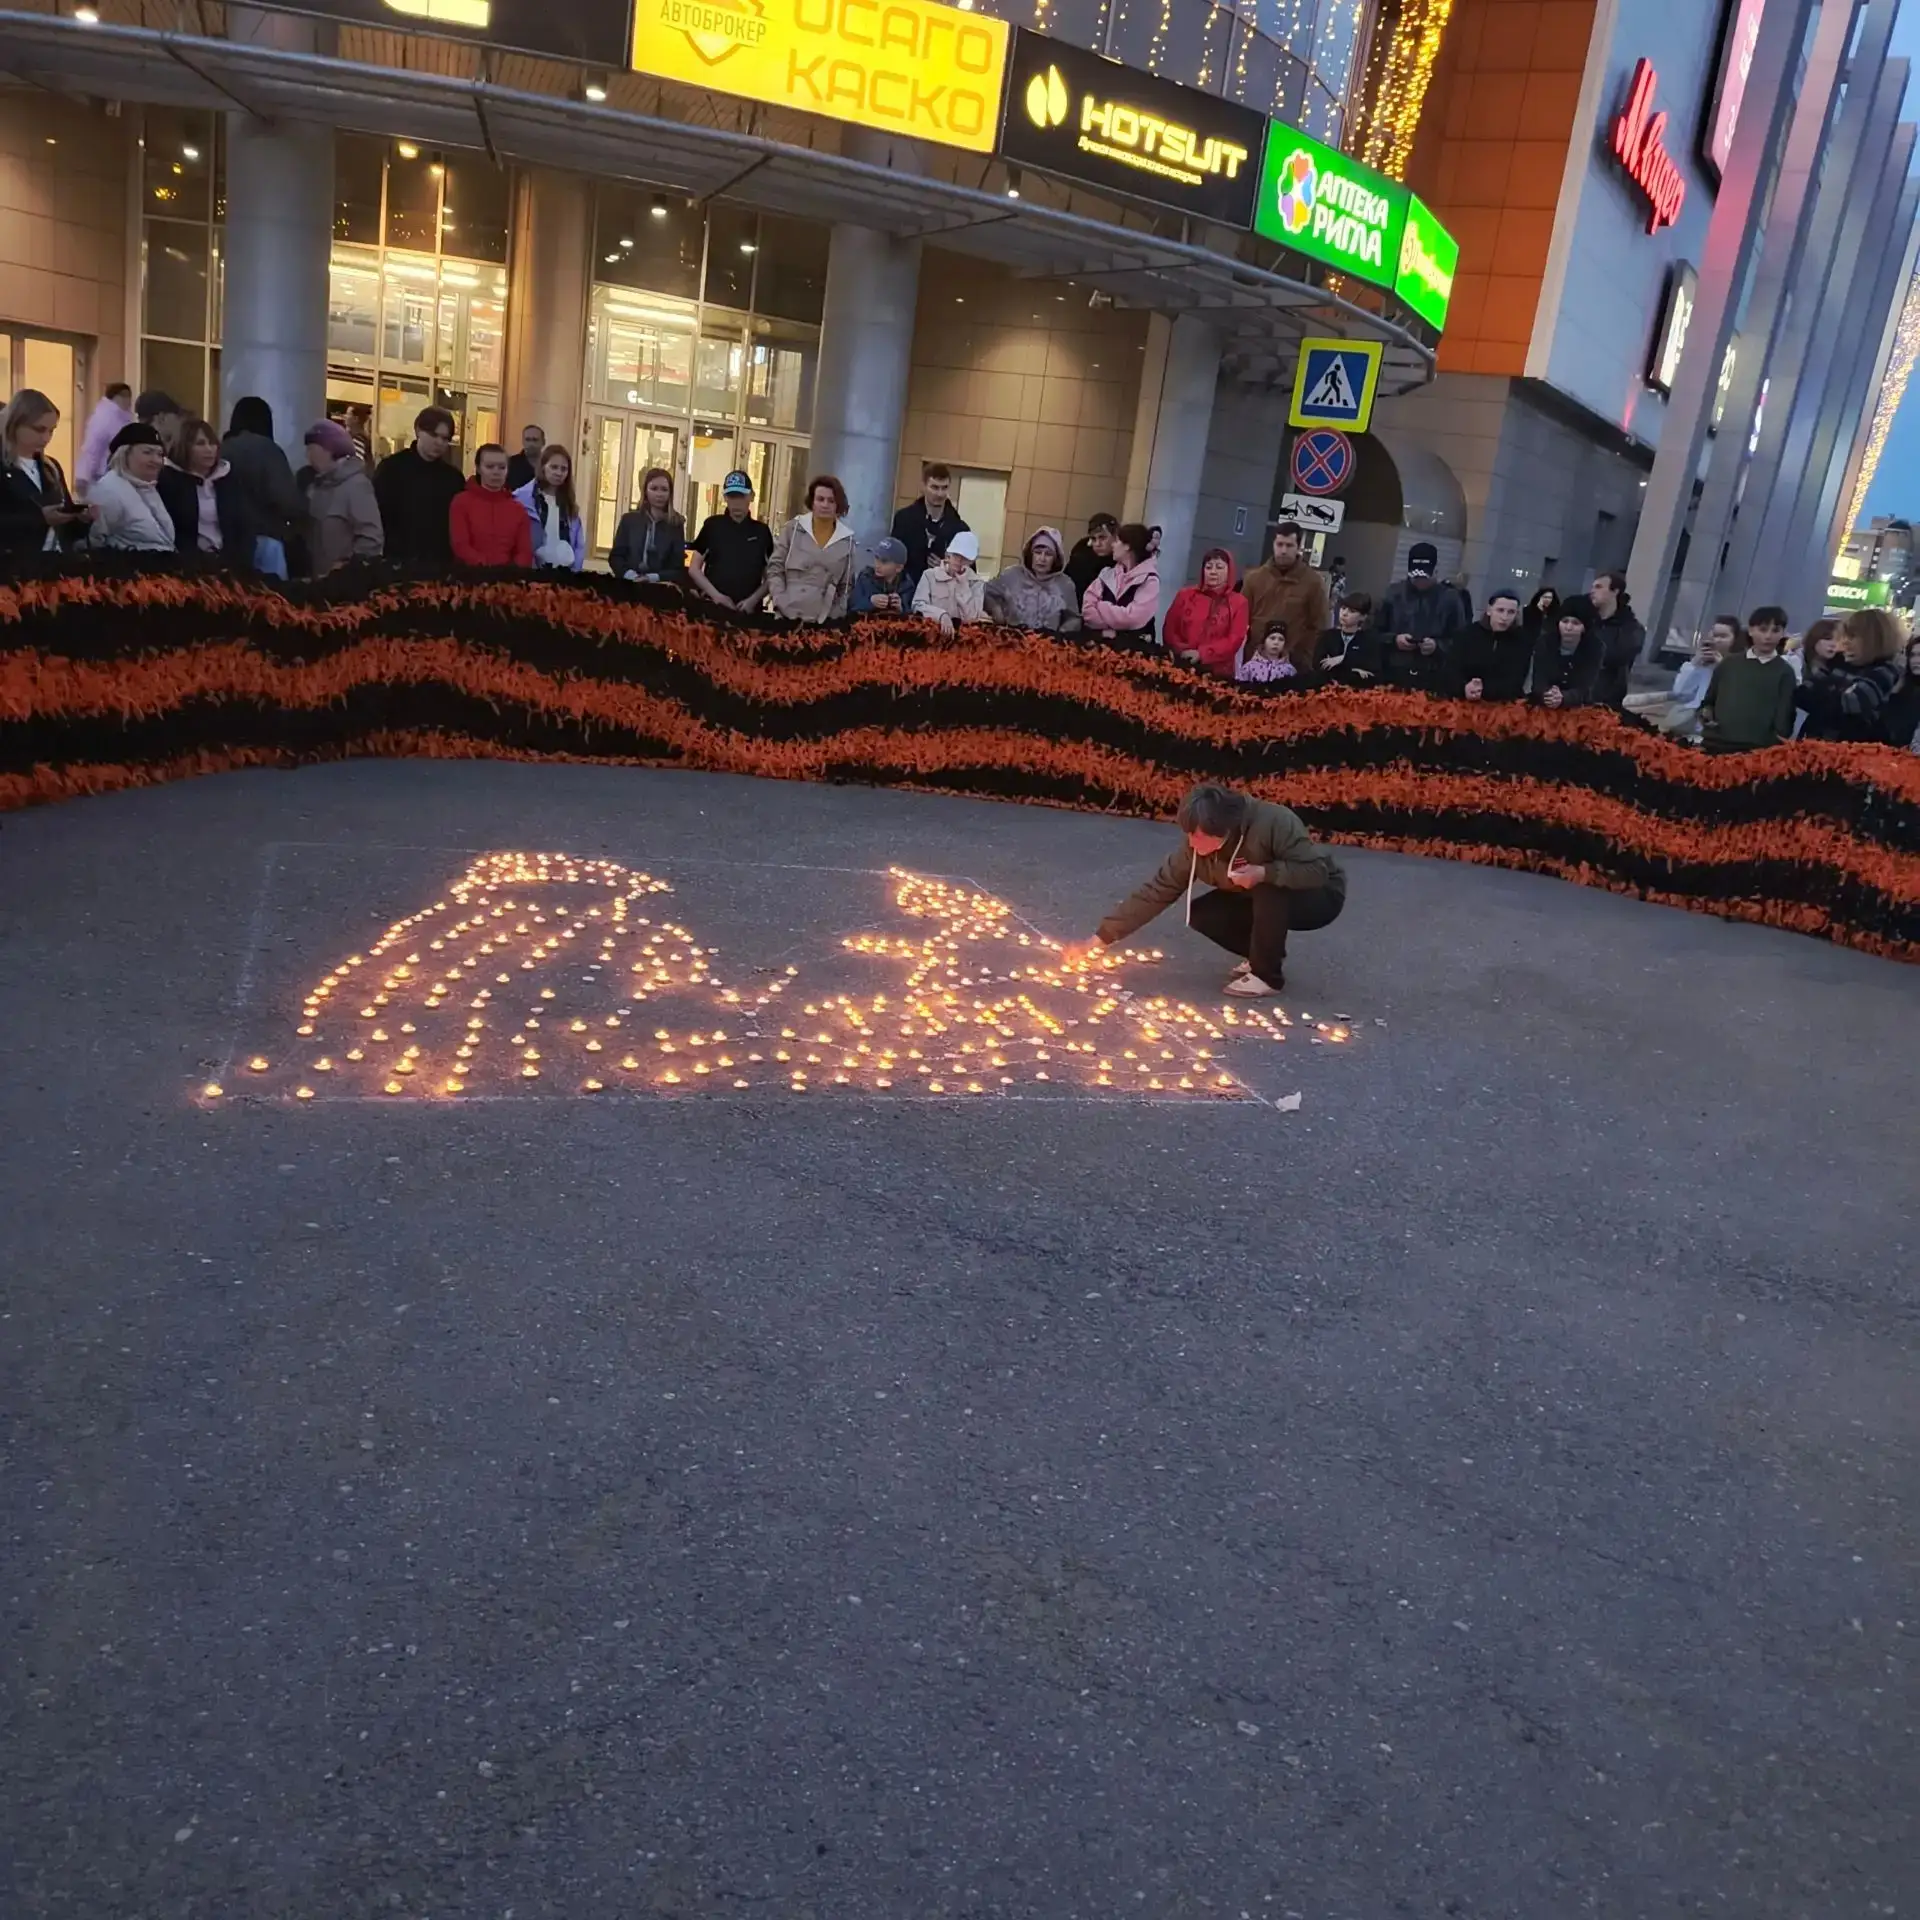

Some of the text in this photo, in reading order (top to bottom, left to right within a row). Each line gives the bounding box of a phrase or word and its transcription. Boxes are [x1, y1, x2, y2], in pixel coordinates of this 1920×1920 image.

[660, 0, 767, 43] АВТОБРОКЕР
[794, 0, 993, 75] ОСАГО
[786, 48, 986, 137] КАСКО
[1081, 95, 1248, 179] HOTSUIT
[1317, 170, 1390, 229] АПТЕКА
[1311, 204, 1383, 268] РИГЛА
